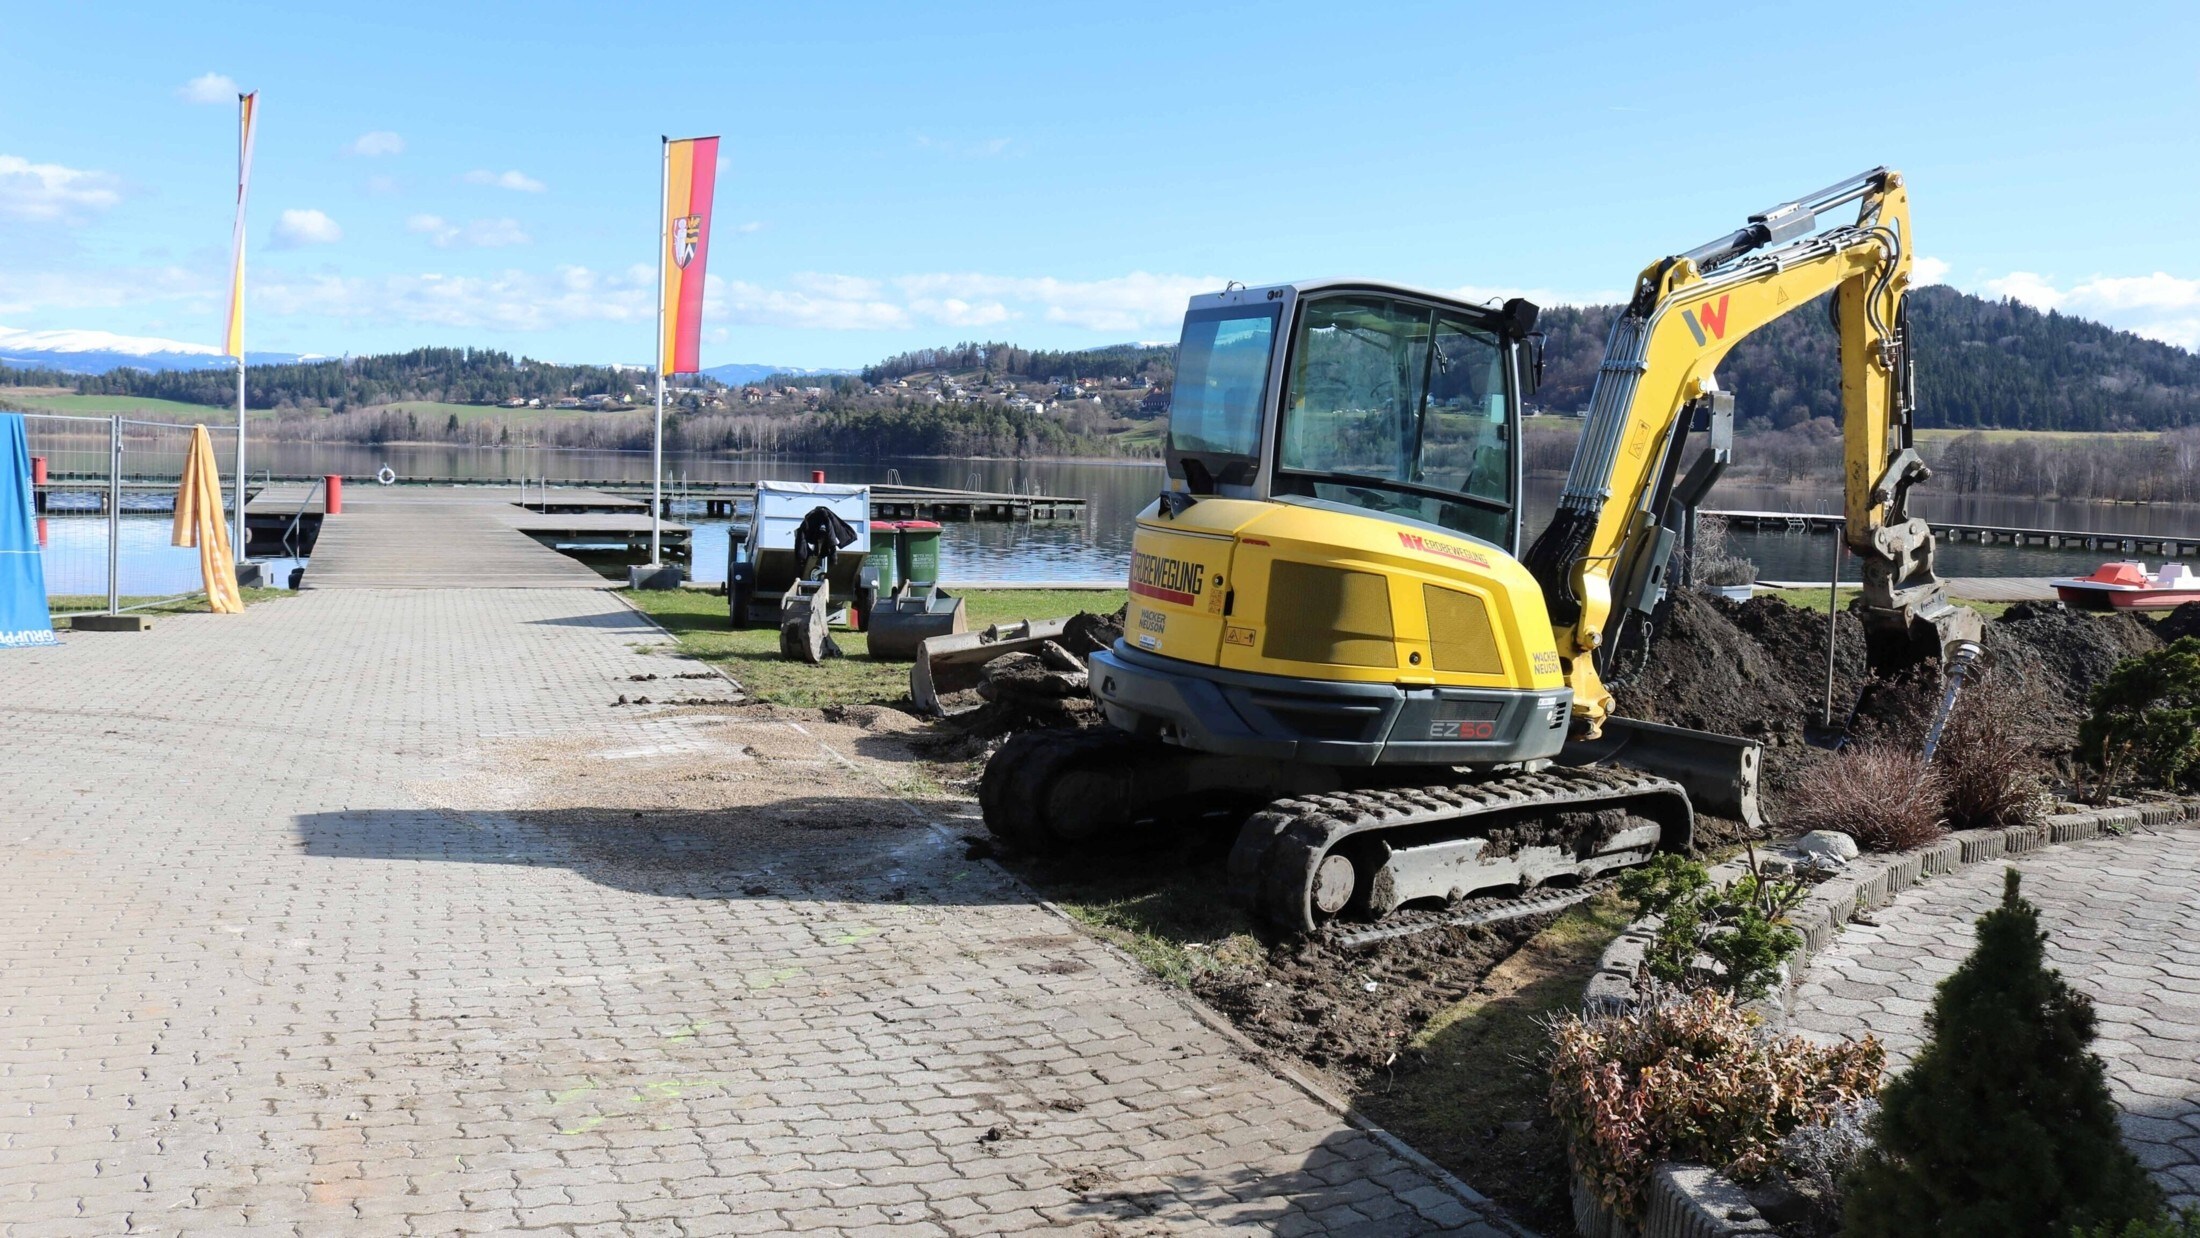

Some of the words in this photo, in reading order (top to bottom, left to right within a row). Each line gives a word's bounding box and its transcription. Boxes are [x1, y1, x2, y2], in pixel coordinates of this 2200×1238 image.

[1132, 552, 1204, 595] ERDBEWEGUNG
[1141, 608, 1166, 624] WACKER
[1139, 619, 1165, 634] NEUSON
[1533, 651, 1558, 663] WACKER
[1534, 662, 1560, 675] NEUSON
[1429, 722, 1494, 738] EZ50
